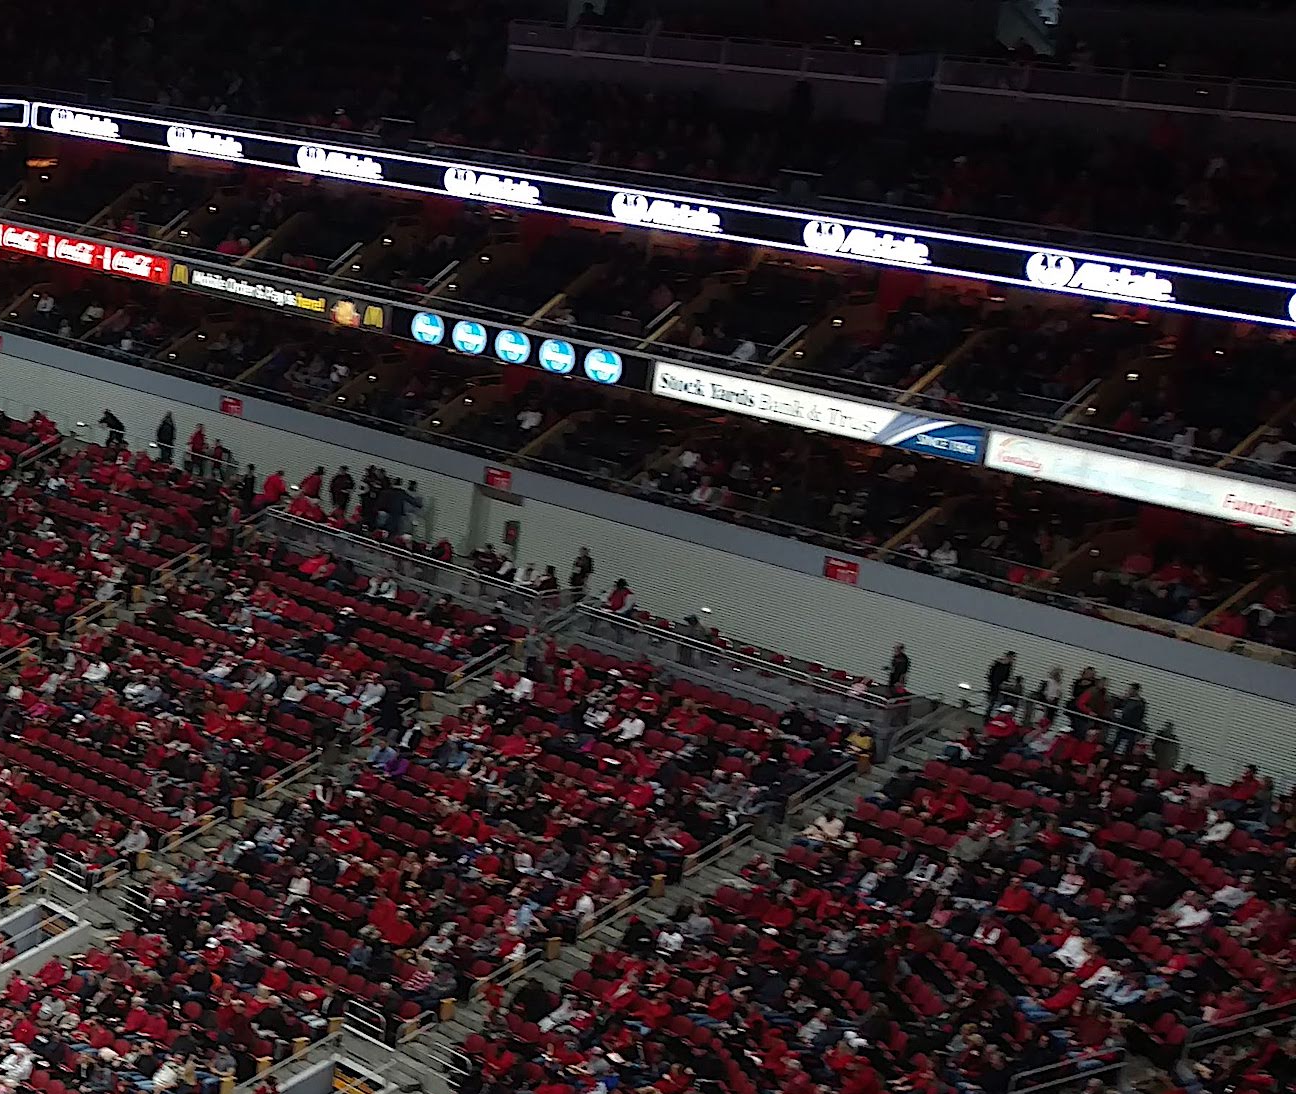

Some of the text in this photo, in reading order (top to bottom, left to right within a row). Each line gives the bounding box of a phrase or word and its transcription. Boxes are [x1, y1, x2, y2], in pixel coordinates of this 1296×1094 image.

[1070, 261, 1177, 302] Allstate
[658, 372, 707, 397] Stock
[709, 383, 755, 407] Yards
[758, 394, 804, 418] Bank
[807, 405, 821, 421] &
